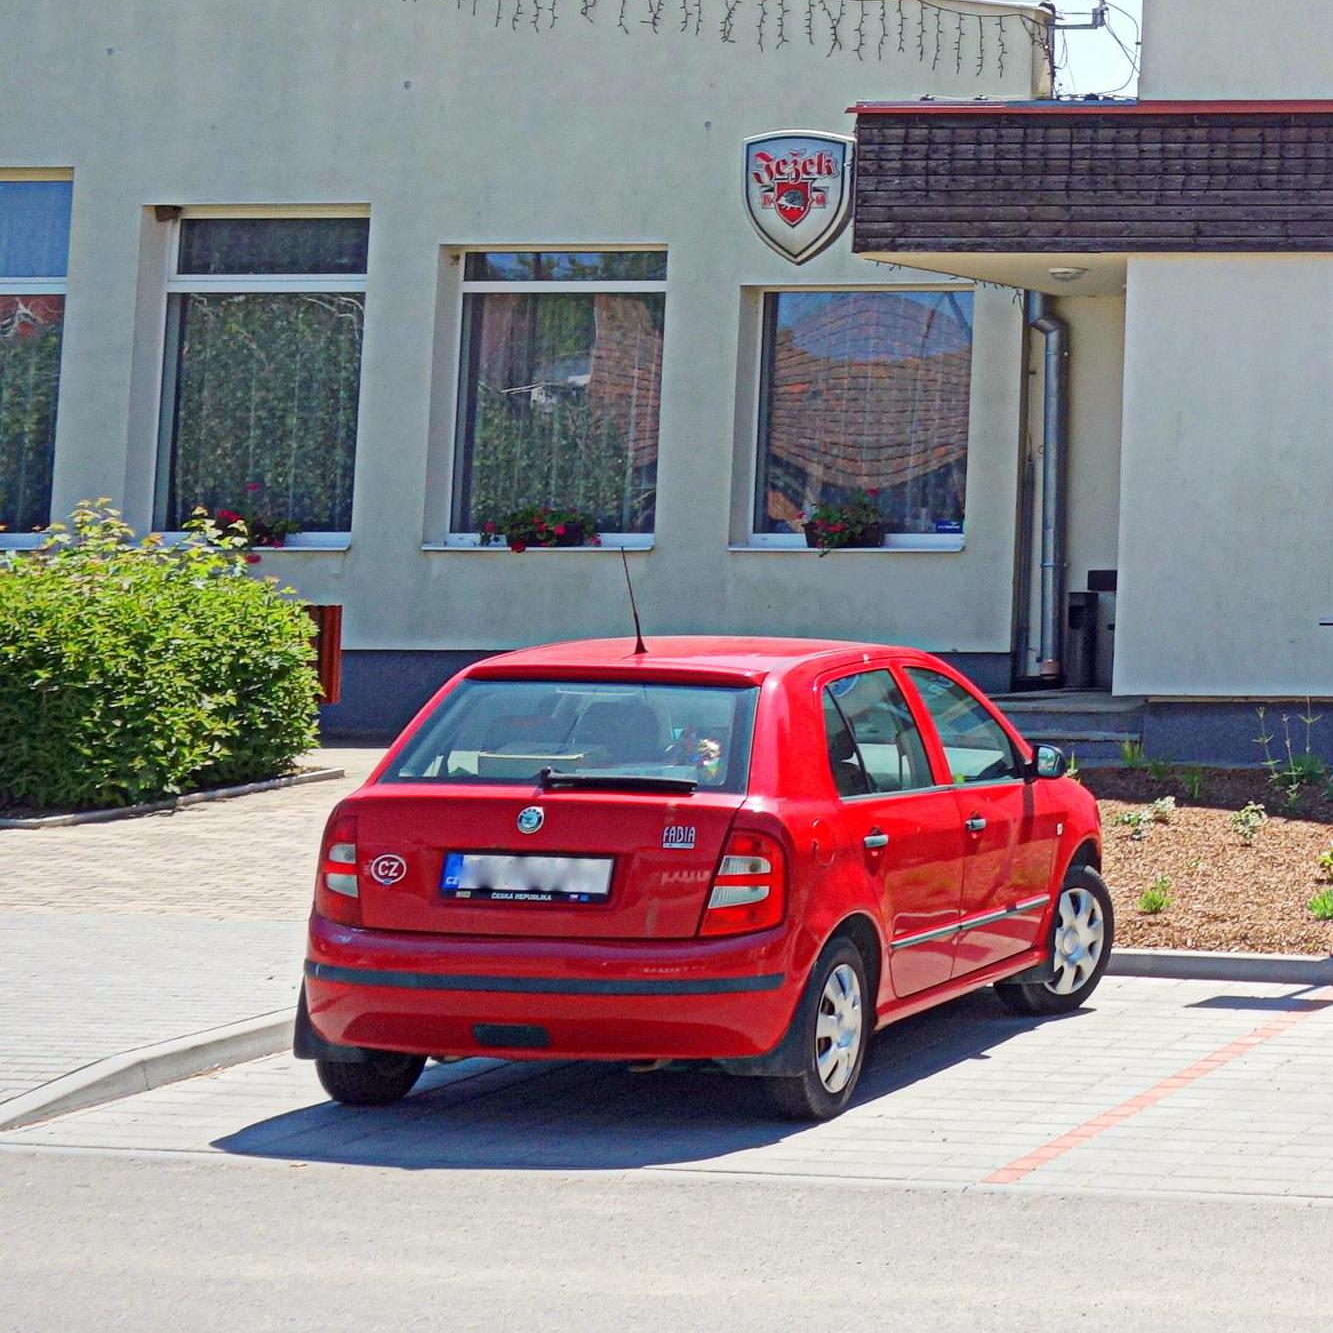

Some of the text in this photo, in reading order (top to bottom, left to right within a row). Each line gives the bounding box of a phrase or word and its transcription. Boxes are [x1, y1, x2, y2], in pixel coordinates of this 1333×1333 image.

[752, 148, 838, 185] Ježek
[662, 825, 696, 843] FABIA
[378, 860, 400, 877] CZ
[446, 875, 459, 885] CZ
